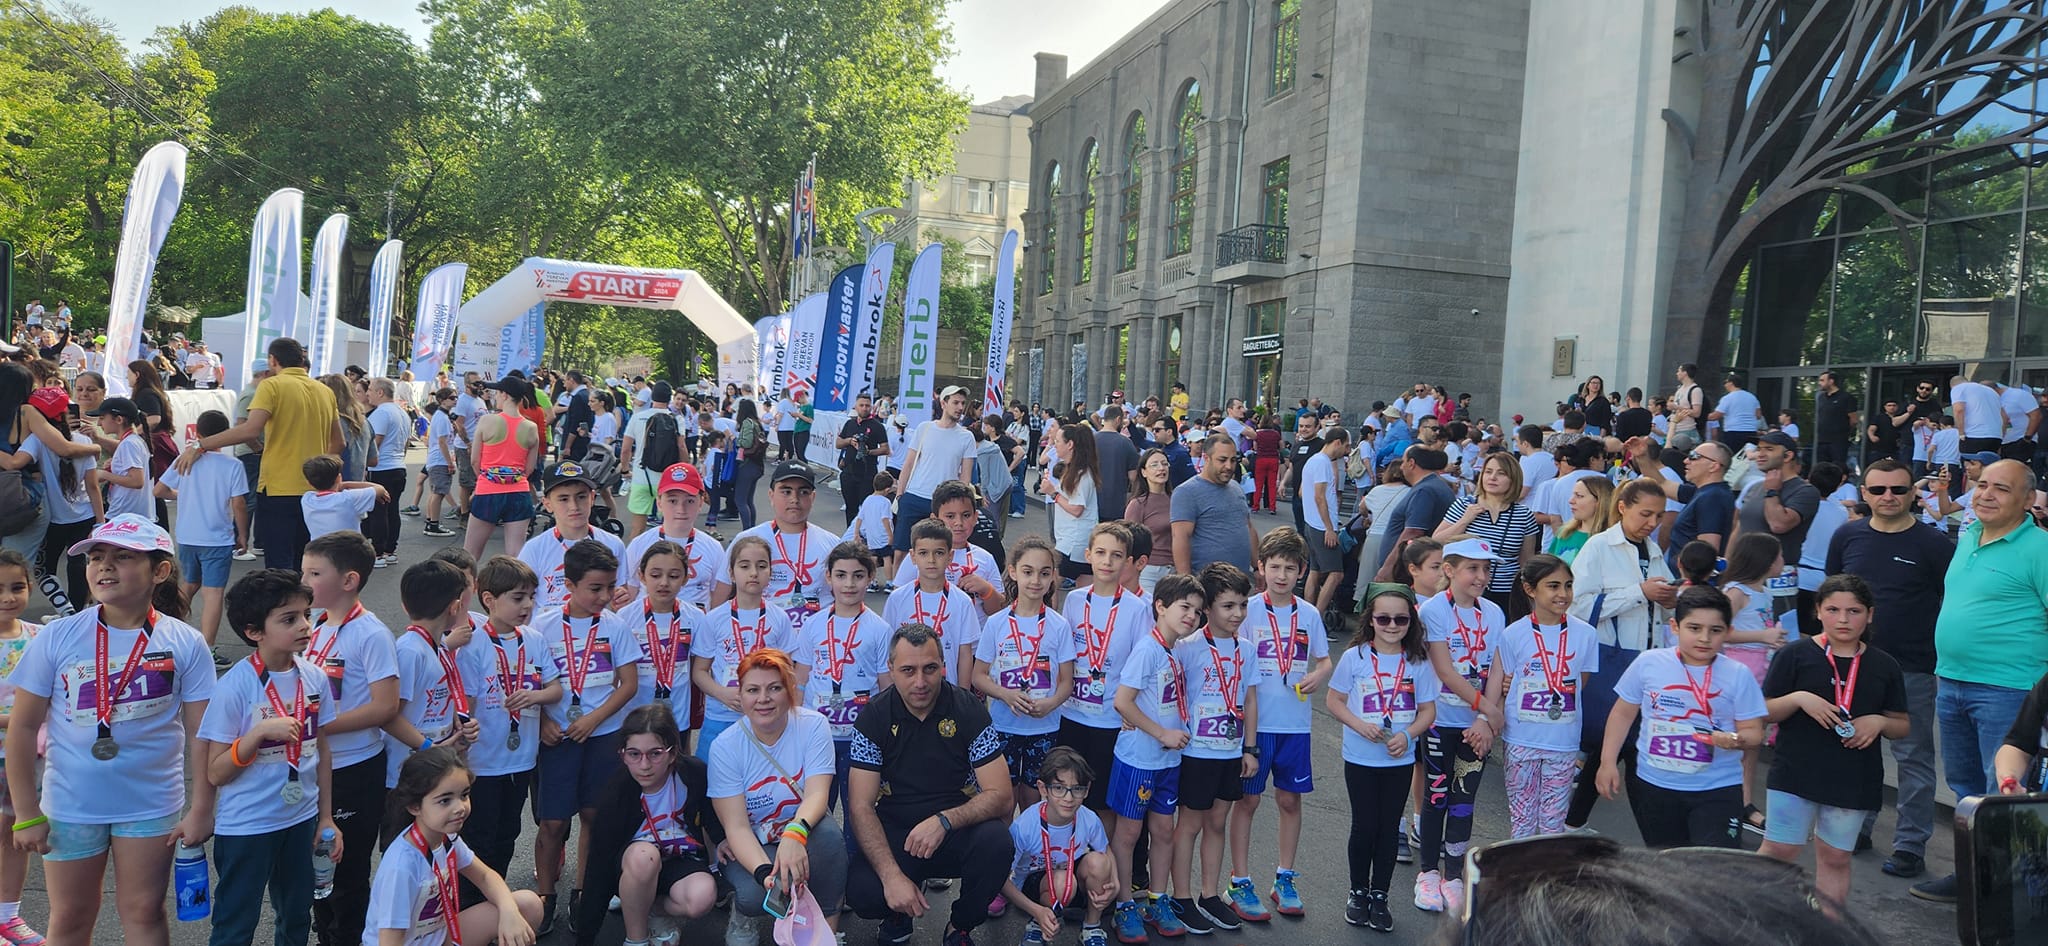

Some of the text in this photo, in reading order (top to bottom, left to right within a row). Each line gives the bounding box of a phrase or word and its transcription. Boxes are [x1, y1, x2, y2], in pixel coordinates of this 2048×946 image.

[578, 274, 650, 296] START
[792, 337, 801, 369] Armbrok
[798, 331, 808, 370] YEREVAN
[806, 332, 815, 371] MARATHON
[903, 297, 931, 410] iHerb
[770, 342, 786, 402] Armbrok
[790, 611, 810, 625] 26
[1073, 681, 1091, 699] 19
[1371, 693, 1406, 710] 174
[1207, 719, 1237, 735] 26
[1657, 737, 1698, 759] 315
[747, 797, 774, 807] YEREVAN
